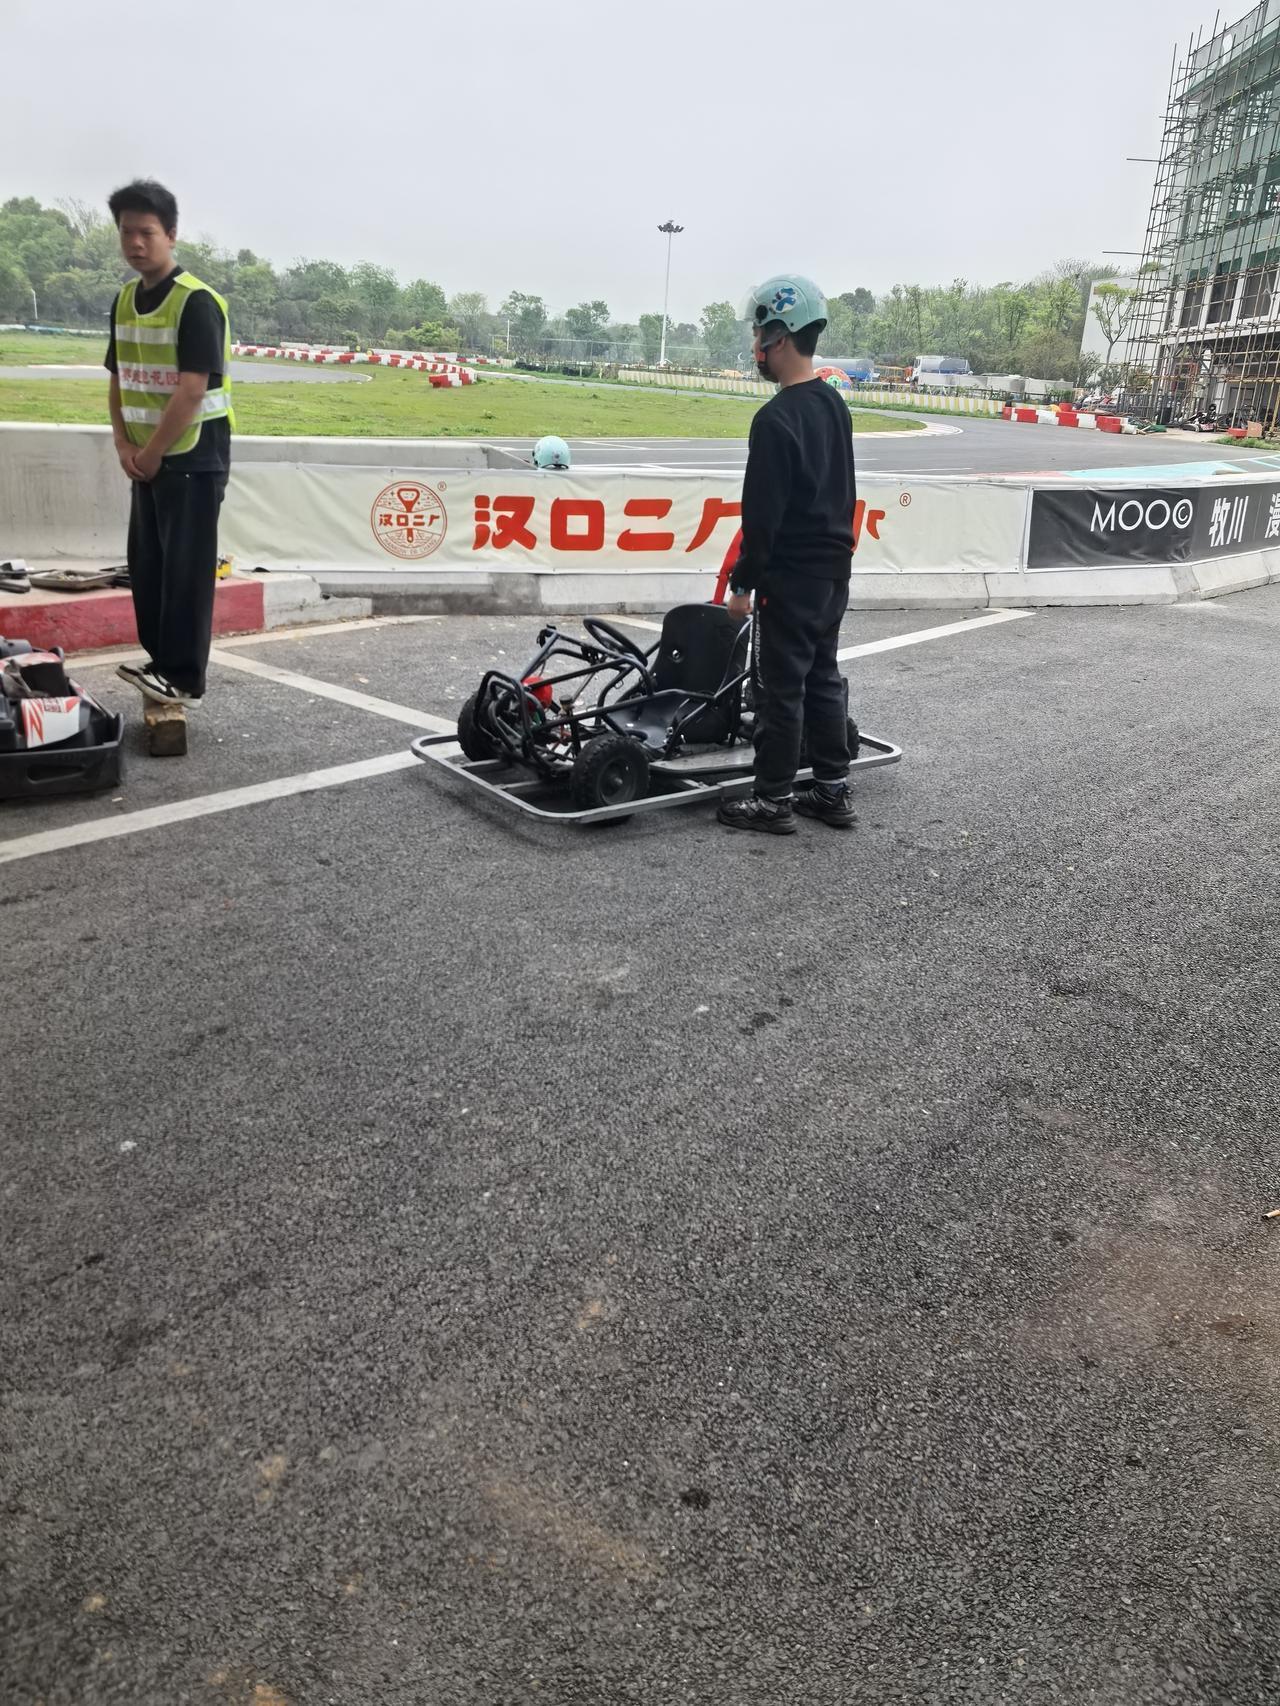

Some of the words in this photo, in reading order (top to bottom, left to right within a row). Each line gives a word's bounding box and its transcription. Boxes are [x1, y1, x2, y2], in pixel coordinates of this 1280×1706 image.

[379, 513, 440, 526] 汉口二厂
[1208, 496, 1249, 547] 牧川
